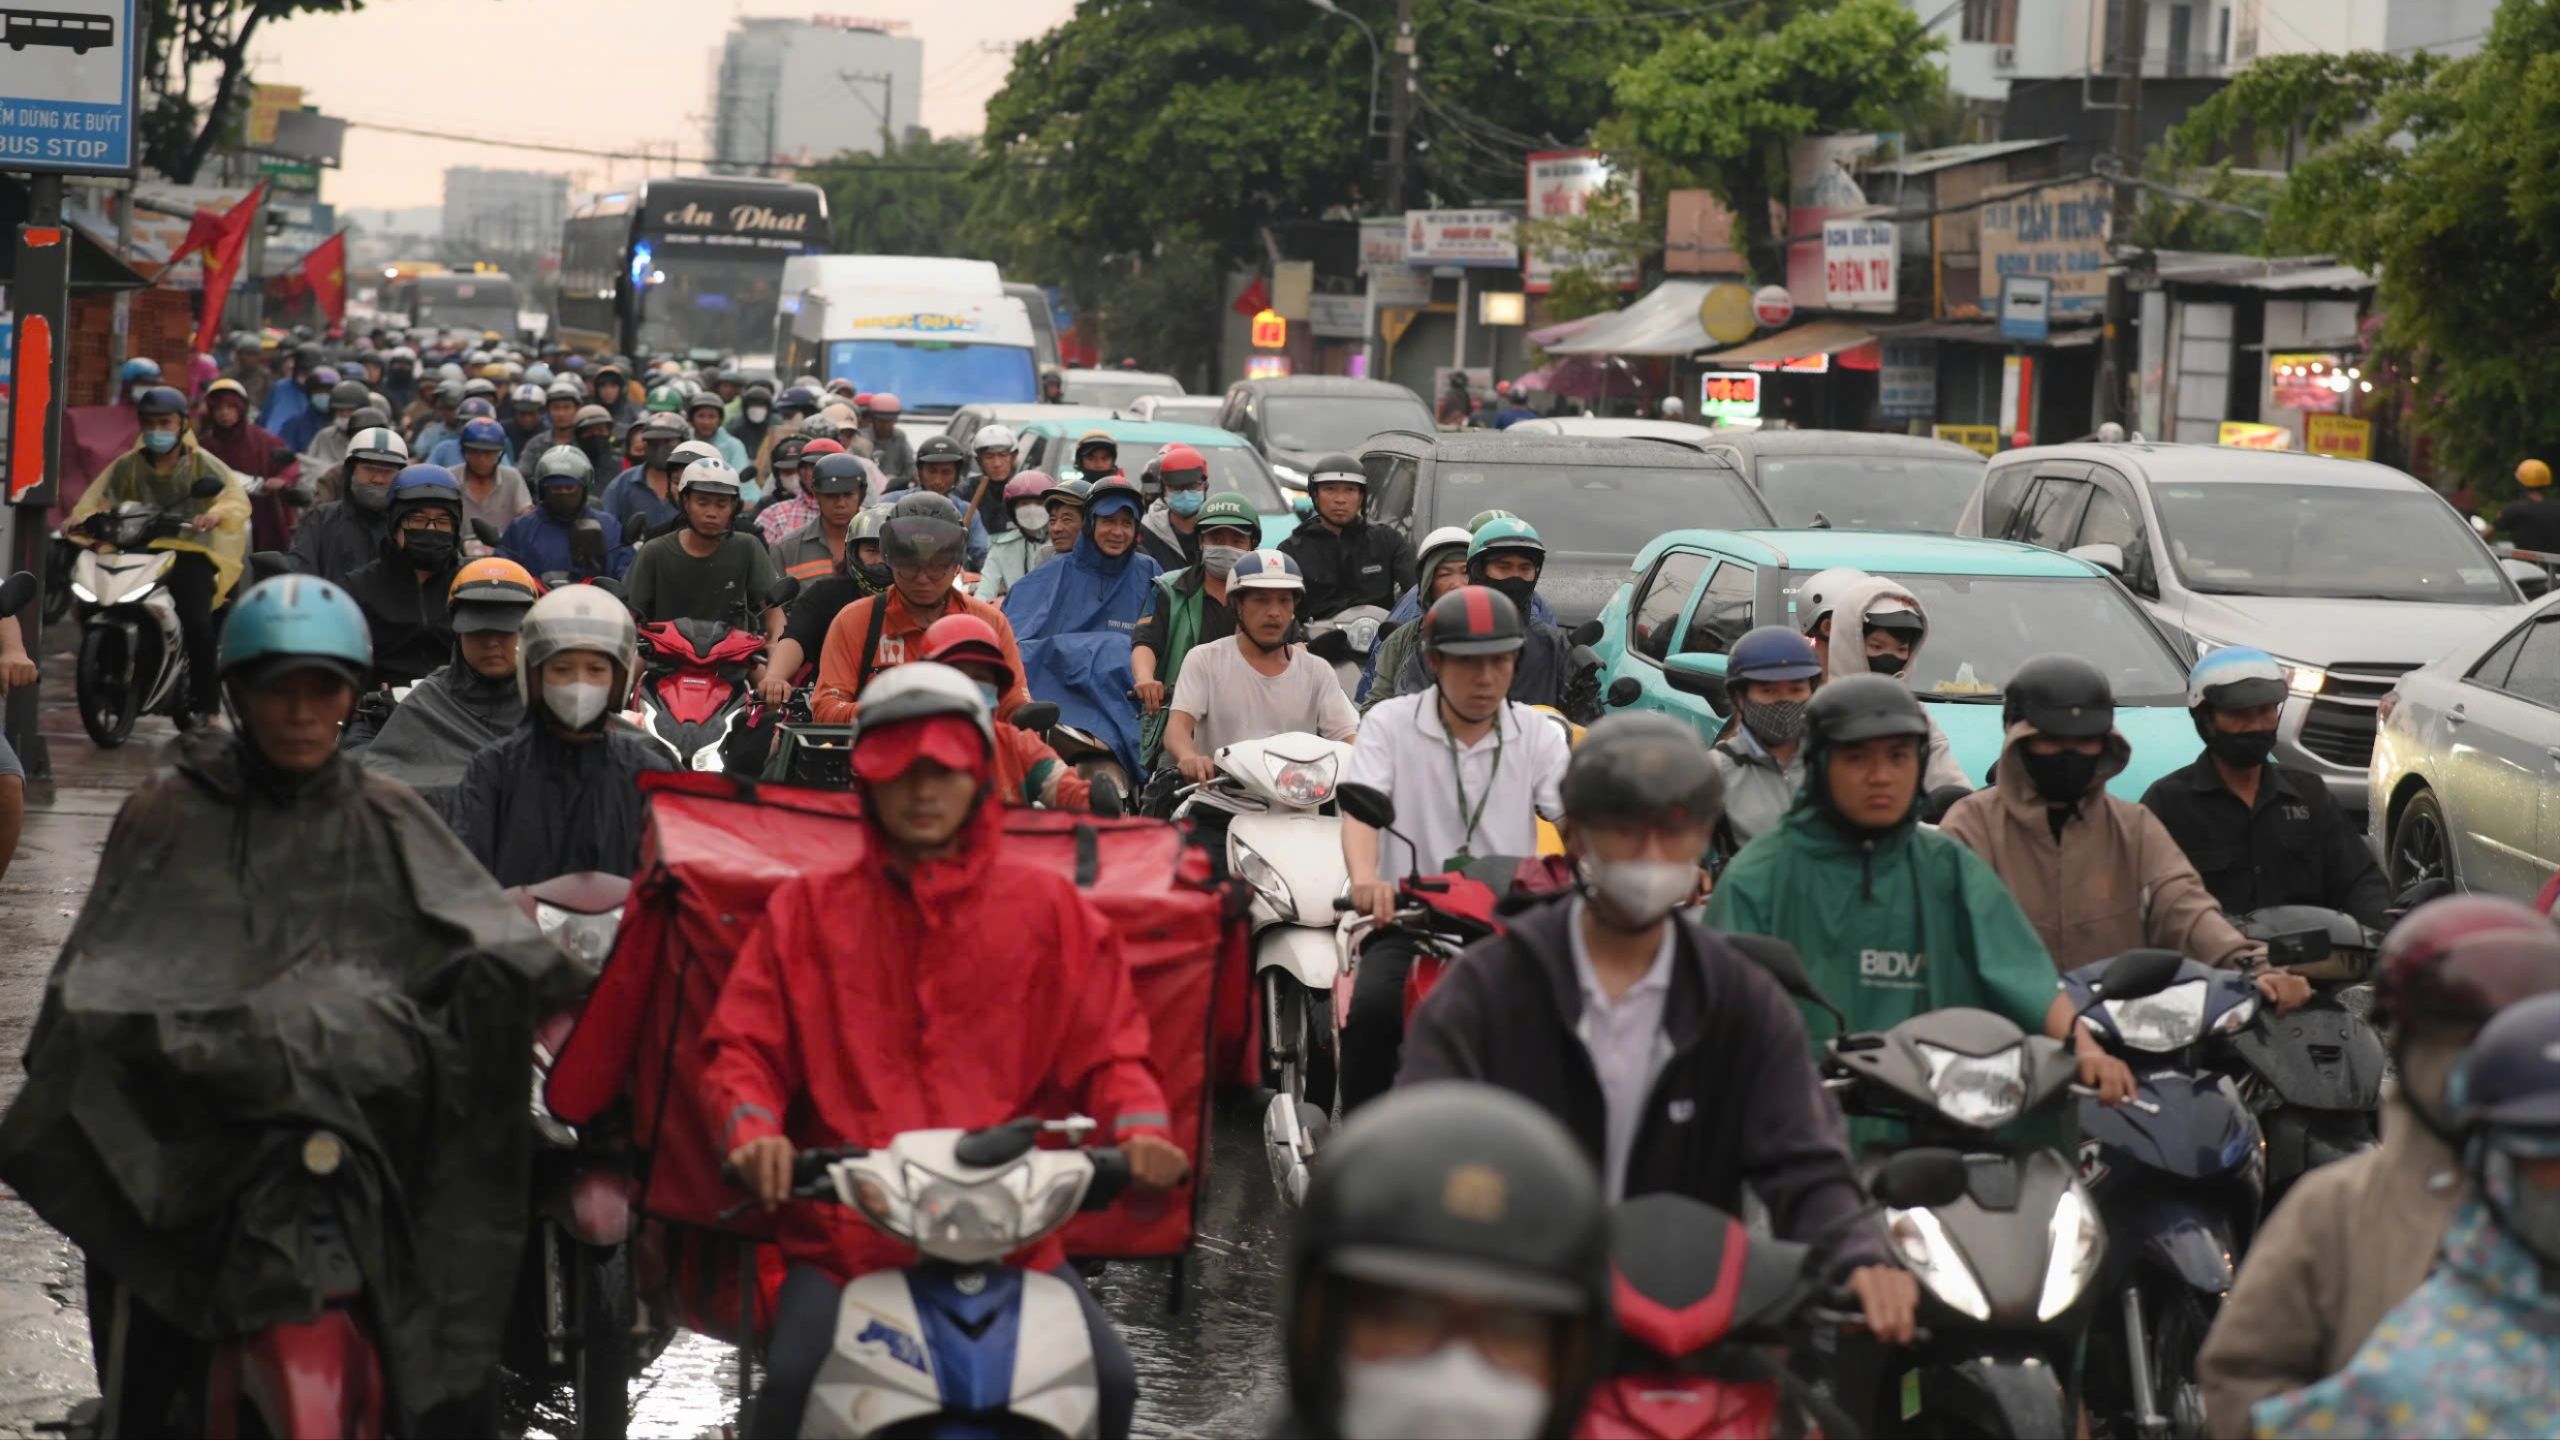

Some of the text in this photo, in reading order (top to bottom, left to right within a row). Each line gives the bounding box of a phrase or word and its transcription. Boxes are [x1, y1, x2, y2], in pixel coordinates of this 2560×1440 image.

[19, 105, 60, 129] DỪNG
[63, 111, 81, 131] XE
[85, 110, 122, 133] BUÝT
[0, 135, 108, 159] BUS STOP
[664, 202, 714, 226] An
[1206, 501, 1241, 513] GHTK
[1861, 948, 1921, 979] BIDV
